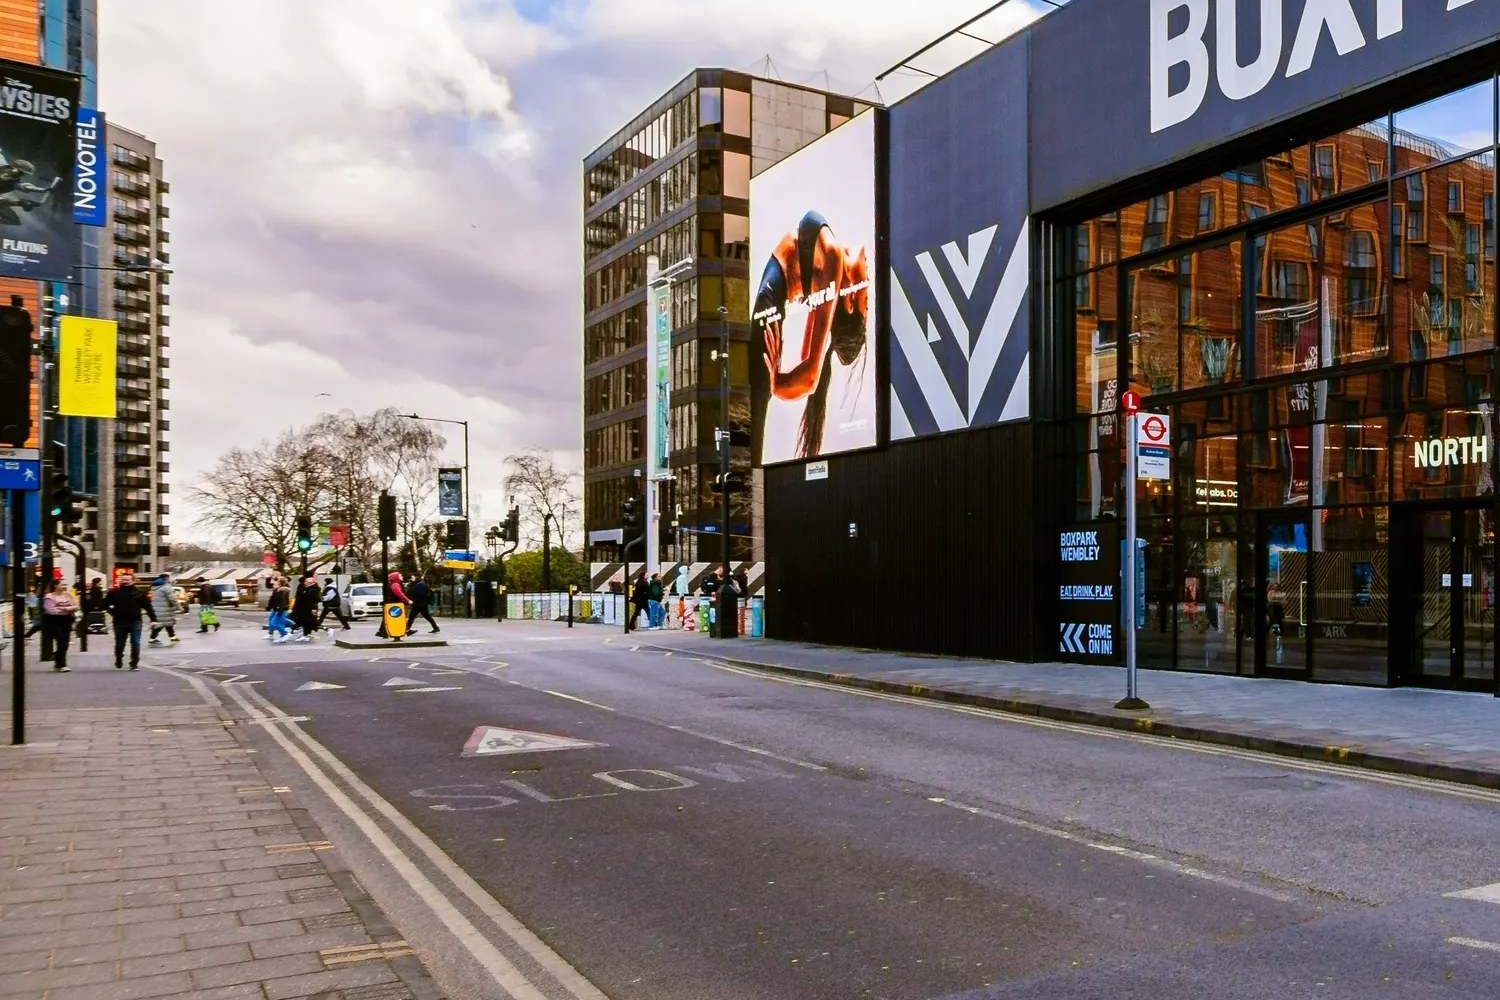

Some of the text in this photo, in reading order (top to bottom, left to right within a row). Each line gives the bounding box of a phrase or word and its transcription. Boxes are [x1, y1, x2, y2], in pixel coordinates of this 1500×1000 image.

[74, 116, 97, 209] NOVOTEL
[3, 238, 48, 255] PLAYING
[1128, 393, 1137, 409] L
[1414, 435, 1487, 468] NORTH
[1060, 531, 1098, 546] BOXPARK
[1061, 546, 1100, 561] WEMBLEY
[1060, 585, 1113, 597] EAT. DRINK. PLAY.
[1088, 623, 1112, 639] COME
[1088, 639, 1113, 655] ON IN!
[408, 760, 798, 812] SLOW
